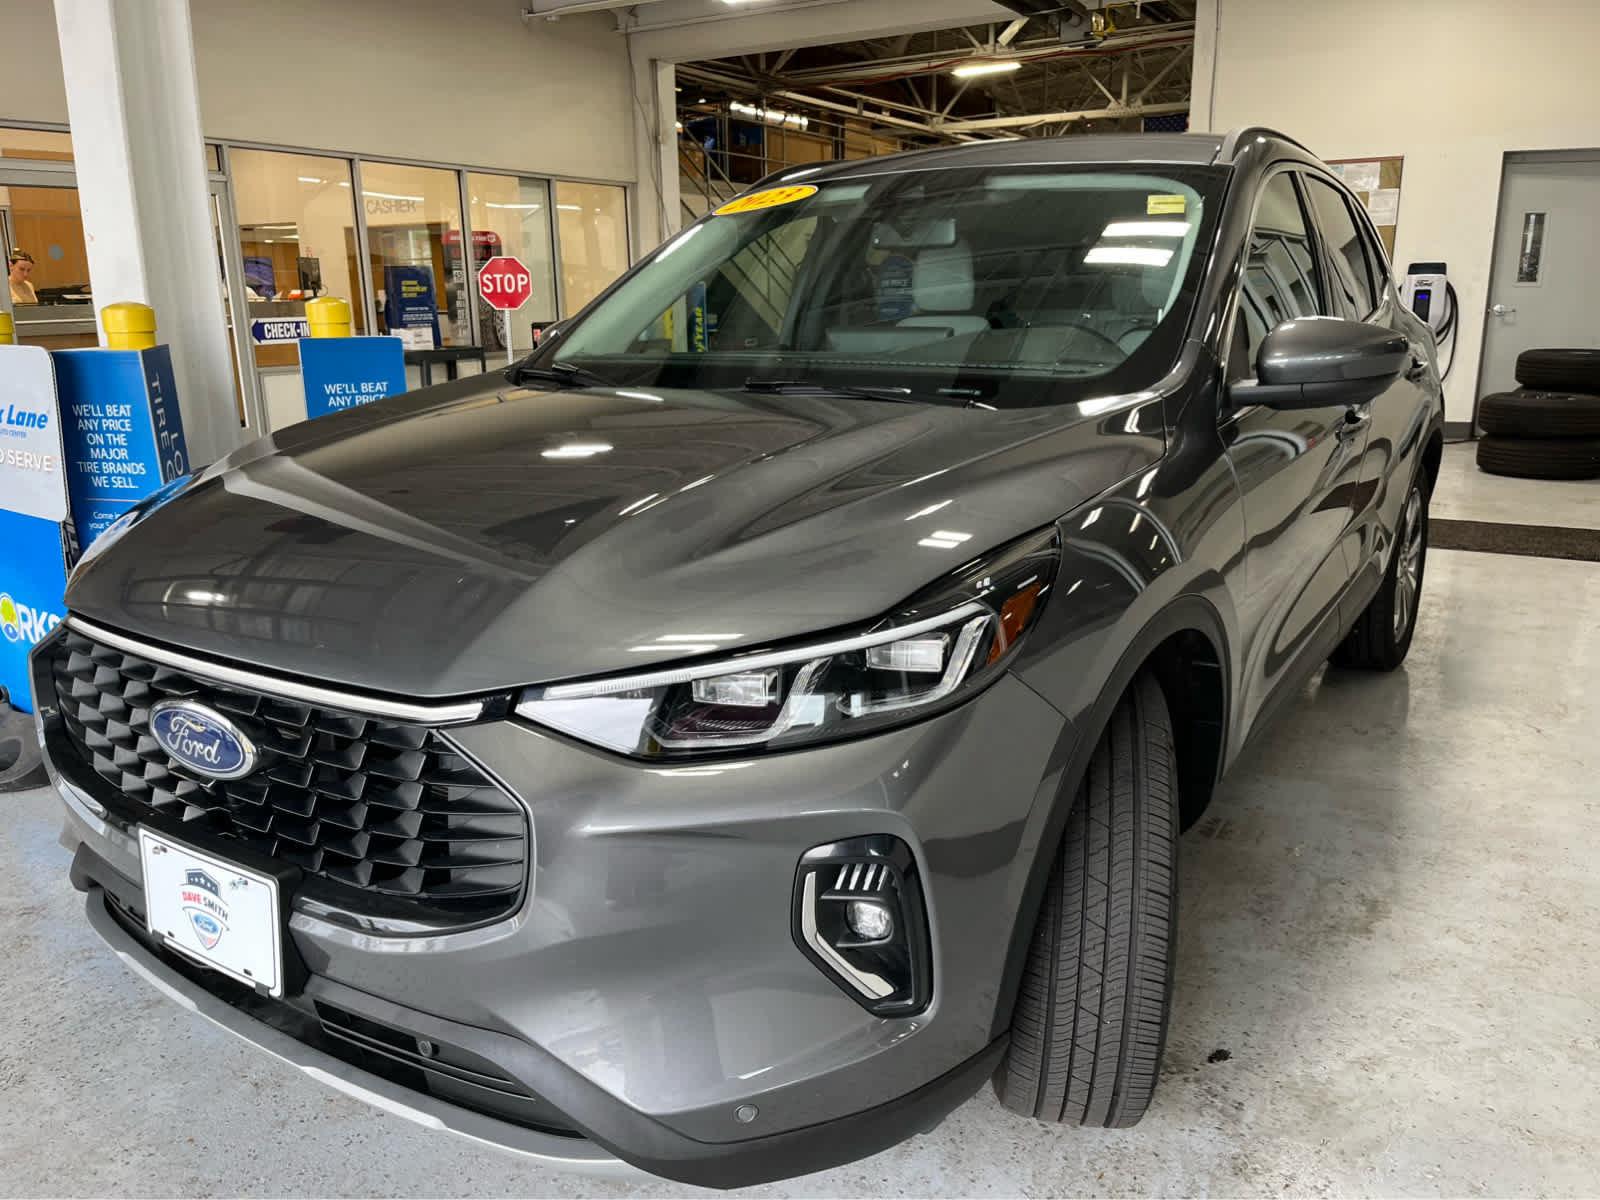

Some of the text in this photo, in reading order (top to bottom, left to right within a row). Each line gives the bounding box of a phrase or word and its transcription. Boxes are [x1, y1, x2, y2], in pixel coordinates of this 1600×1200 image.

[482, 273, 529, 294] STOP
[263, 322, 311, 338] CHECK-IN
[324, 381, 389, 394] WE'LL BEAT
[328, 396, 352, 408] ANY
[6, 404, 48, 429] Lane
[72, 404, 132, 417] WE'LL BEAT
[152, 373, 170, 451] TIRE
[78, 418, 133, 431] ANY PRICE
[86, 432, 128, 446] ON THE
[90, 447, 129, 460] MAJOR
[7, 449, 54, 473] SERVE
[77, 461, 147, 475] TIRE BRANDS
[91, 475, 110, 488] WE
[93, 511, 113, 520] Come
[88, 522, 104, 530] your
[167, 716, 221, 764] Ford
[182, 891, 229, 921] DAVE SMITH
